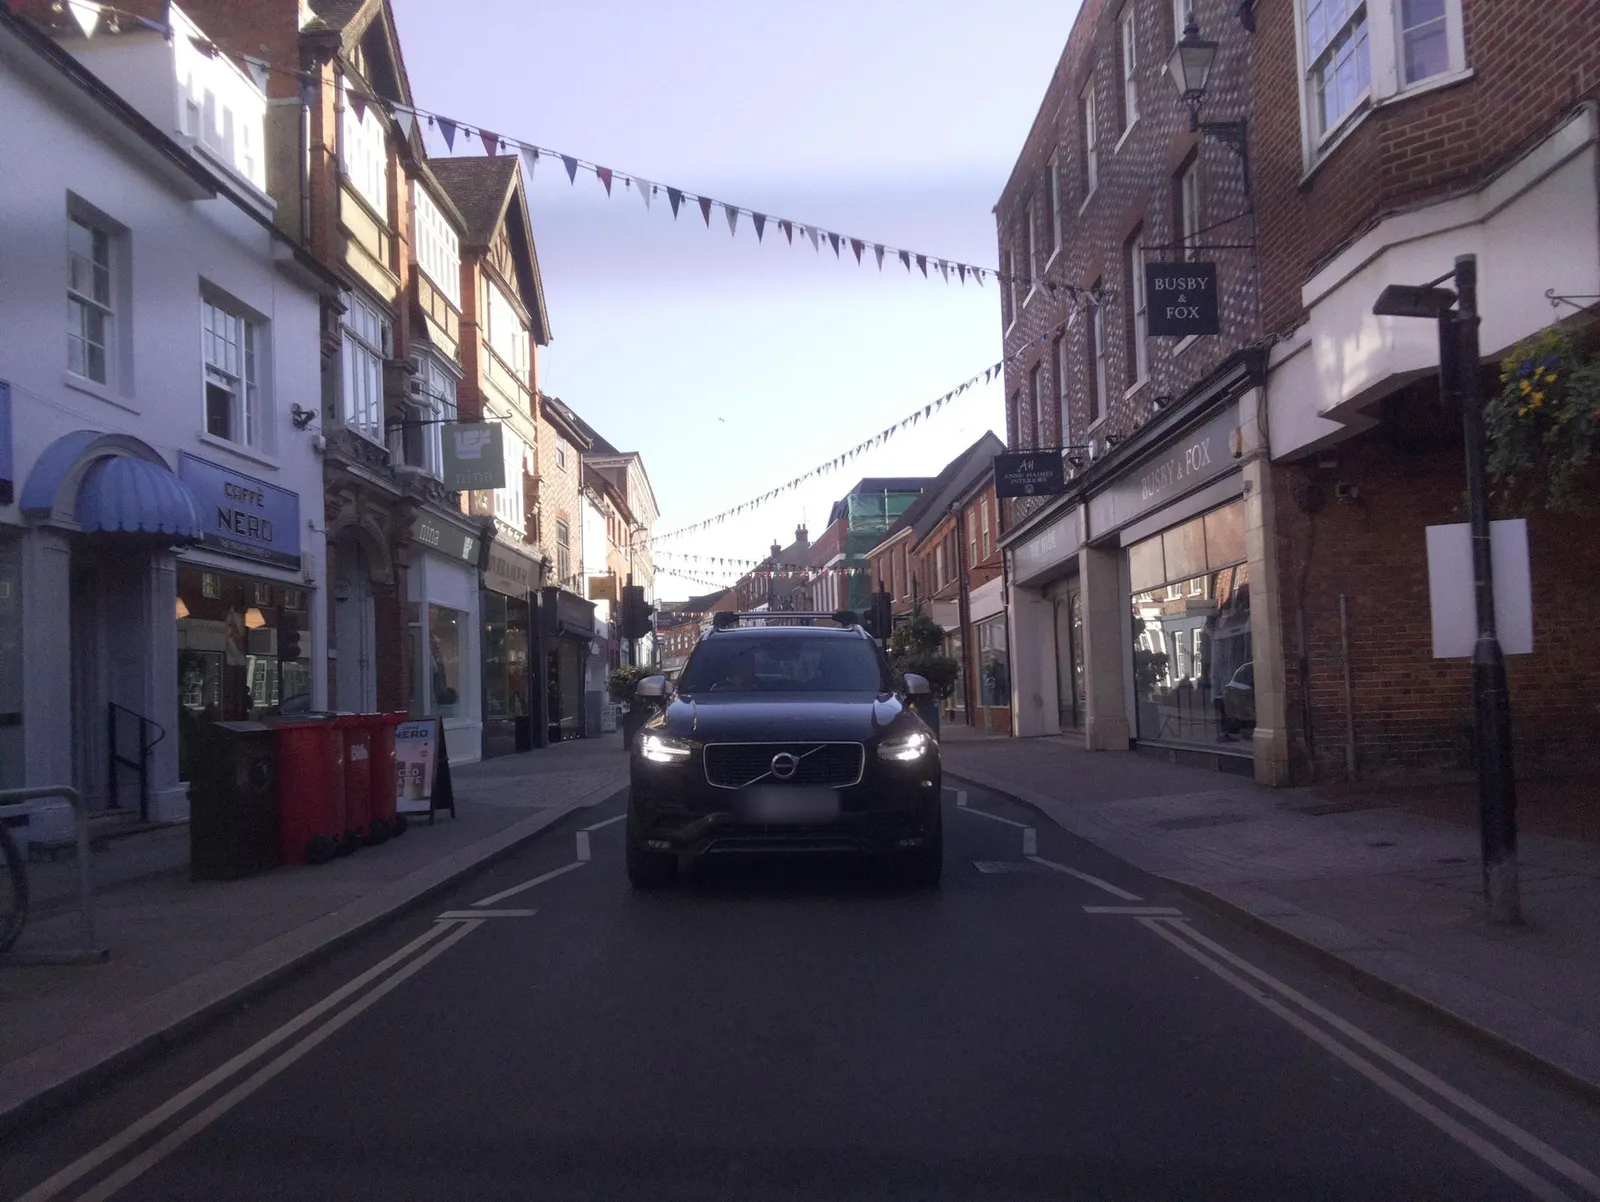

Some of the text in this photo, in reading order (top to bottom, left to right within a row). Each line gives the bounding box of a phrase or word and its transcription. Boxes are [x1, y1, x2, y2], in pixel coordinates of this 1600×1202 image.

[1154, 277, 1209, 291] BUSBY
[1178, 293, 1187, 303] &
[1166, 306, 1200, 319] FOX
[1141, 459, 1175, 500] BUSBY
[1185, 437, 1211, 475] FOX
[456, 470, 492, 484] nina
[217, 505, 273, 543] NERO
[419, 520, 440, 546] nina
[397, 768, 419, 777] CED
[397, 775, 422, 785] ATTE
